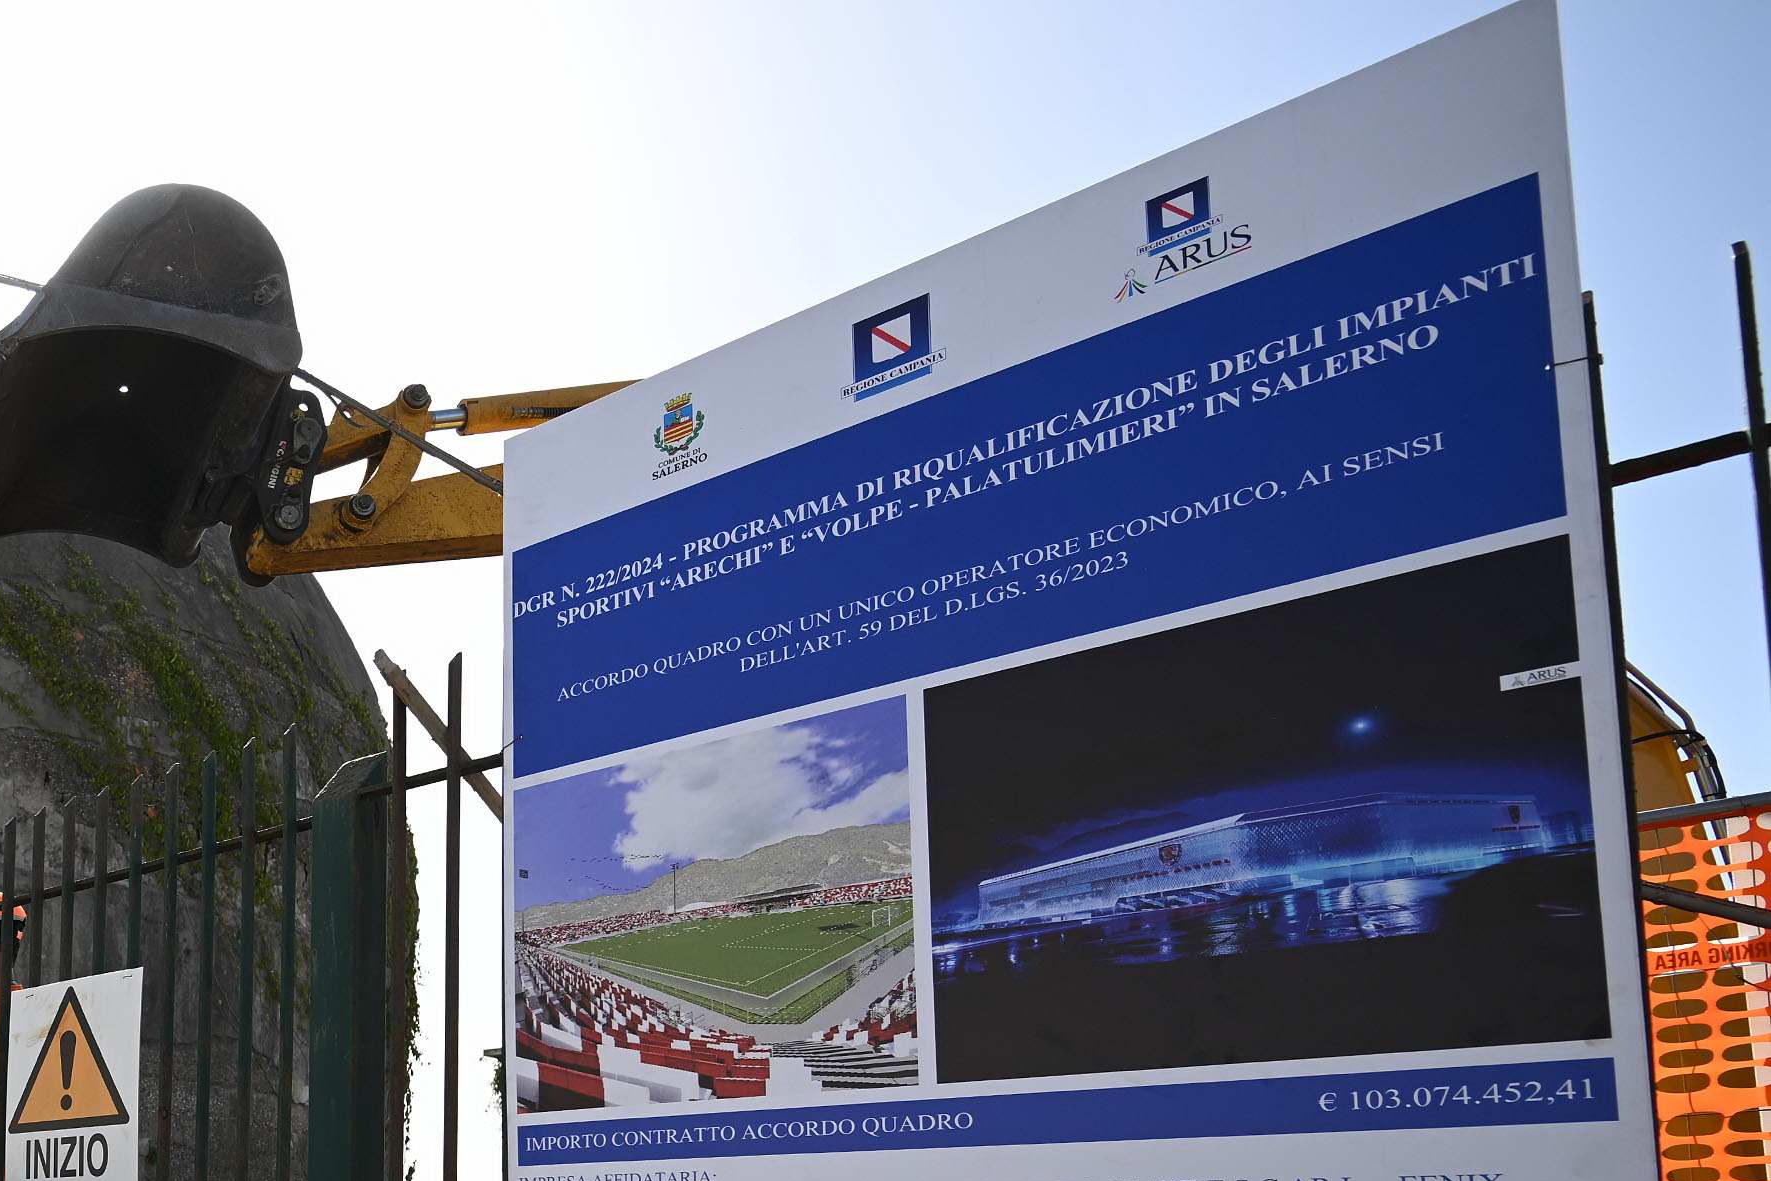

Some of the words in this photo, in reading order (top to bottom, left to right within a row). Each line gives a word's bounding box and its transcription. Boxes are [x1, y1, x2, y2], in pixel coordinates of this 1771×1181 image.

[1155, 224, 1251, 280] ARUS
[843, 374, 887, 396] REGIONE
[890, 352, 943, 377] CAMPANIA
[512, 590, 556, 620] DGR
[560, 581, 580, 602] N.
[585, 551, 664, 594] 222/2024
[682, 490, 849, 562] PROGRAMMA
[857, 475, 884, 503] DI
[893, 368, 1198, 491] RIQUALIFICAZIONE
[1208, 323, 1325, 385] DEGLI
[1339, 252, 1535, 341] IMPIANTI
[658, 451, 690, 468] COMUNE
[692, 448, 701, 456] DI
[556, 580, 655, 628] SPORTIVI
[659, 541, 774, 592] “ARECHI”
[780, 534, 796, 556] E
[801, 498, 903, 543] “VOLPE
[925, 401, 1195, 509] PALATULIMIERI”
[1205, 386, 1240, 418] IN
[1251, 324, 1439, 403] SALERNO
[652, 453, 707, 480] SALERNO
[557, 662, 649, 702] ACCORDO
[653, 635, 742, 675] QUADRO
[746, 619, 792, 646] CON
[799, 607, 832, 632] UN
[838, 585, 915, 620] UNICO
[921, 535, 1081, 596] OPERATORE
[1088, 480, 1287, 550] ECONOMICO,
[1296, 463, 1331, 491] AI
[1343, 431, 1443, 477] SENSI
[740, 628, 852, 673] DELL'ART.
[858, 619, 882, 640] 59
[889, 604, 938, 632] DEL
[945, 579, 1027, 616] D.LGS.
[1035, 550, 1129, 592] 36/2023
[1527, 666, 1566, 681] ARUS
[1318, 1091, 1337, 1112] €
[1351, 1077, 1593, 1111] 103.074.452,41
[526, 1132, 607, 1152] IMPORTO
[611, 1124, 736, 1147] CONTRATTO
[741, 1117, 856, 1140] ACCORDO
[862, 1110, 974, 1138] QUADRO
[25, 1133, 109, 1179] INIZIO
